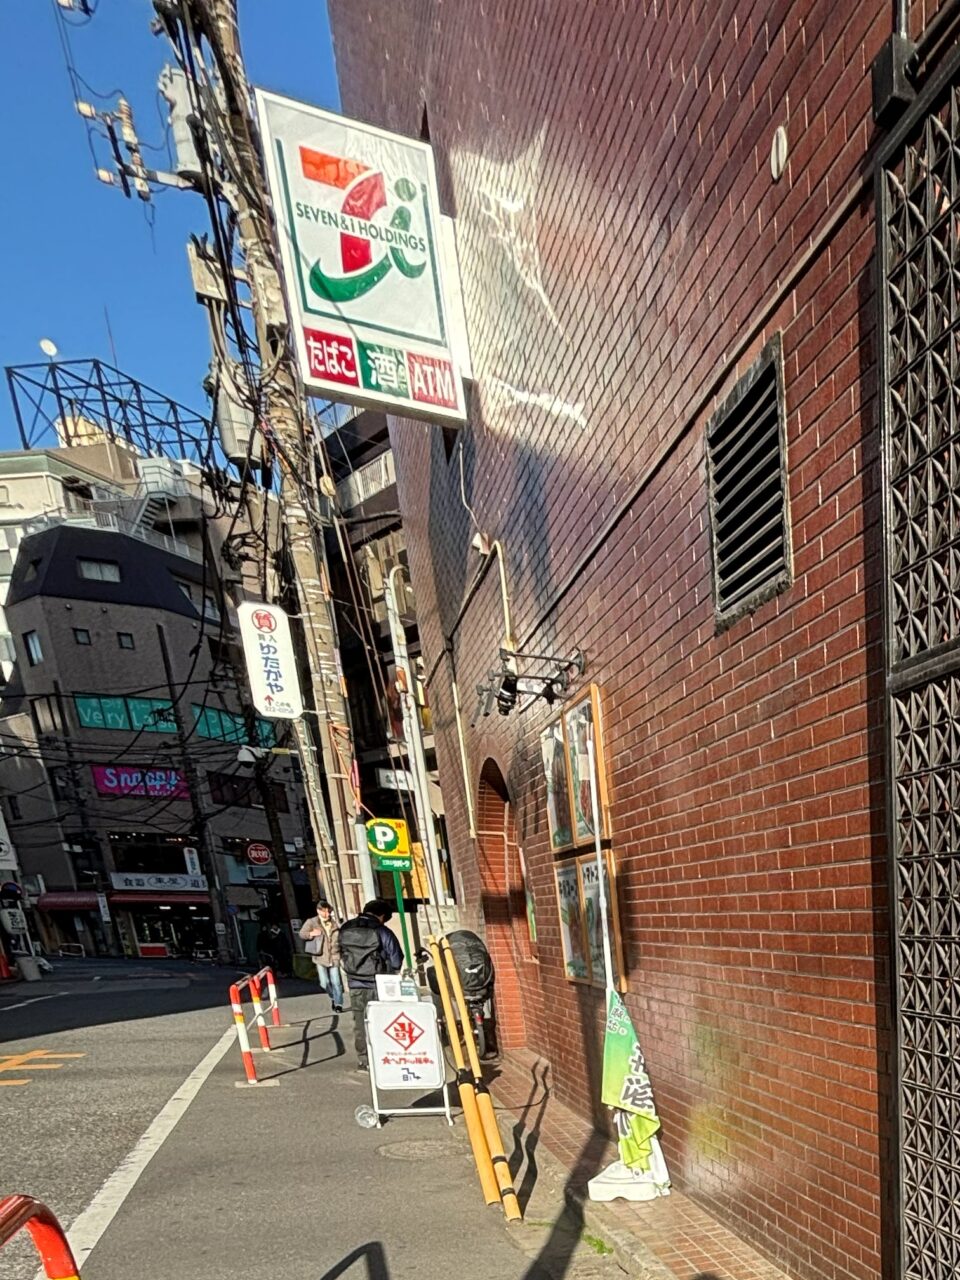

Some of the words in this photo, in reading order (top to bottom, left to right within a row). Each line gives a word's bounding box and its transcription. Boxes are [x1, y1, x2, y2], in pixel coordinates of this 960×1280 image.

[358, 220, 426, 252] HOLDINGS
[306, 336, 356, 378] たばこ
[366, 349, 399, 388] 酒
[412, 361, 456, 401] ATM
[260, 642, 284, 695] ゆたかや
[79, 707, 125, 728] Very
[374, 826, 395, 850] P
